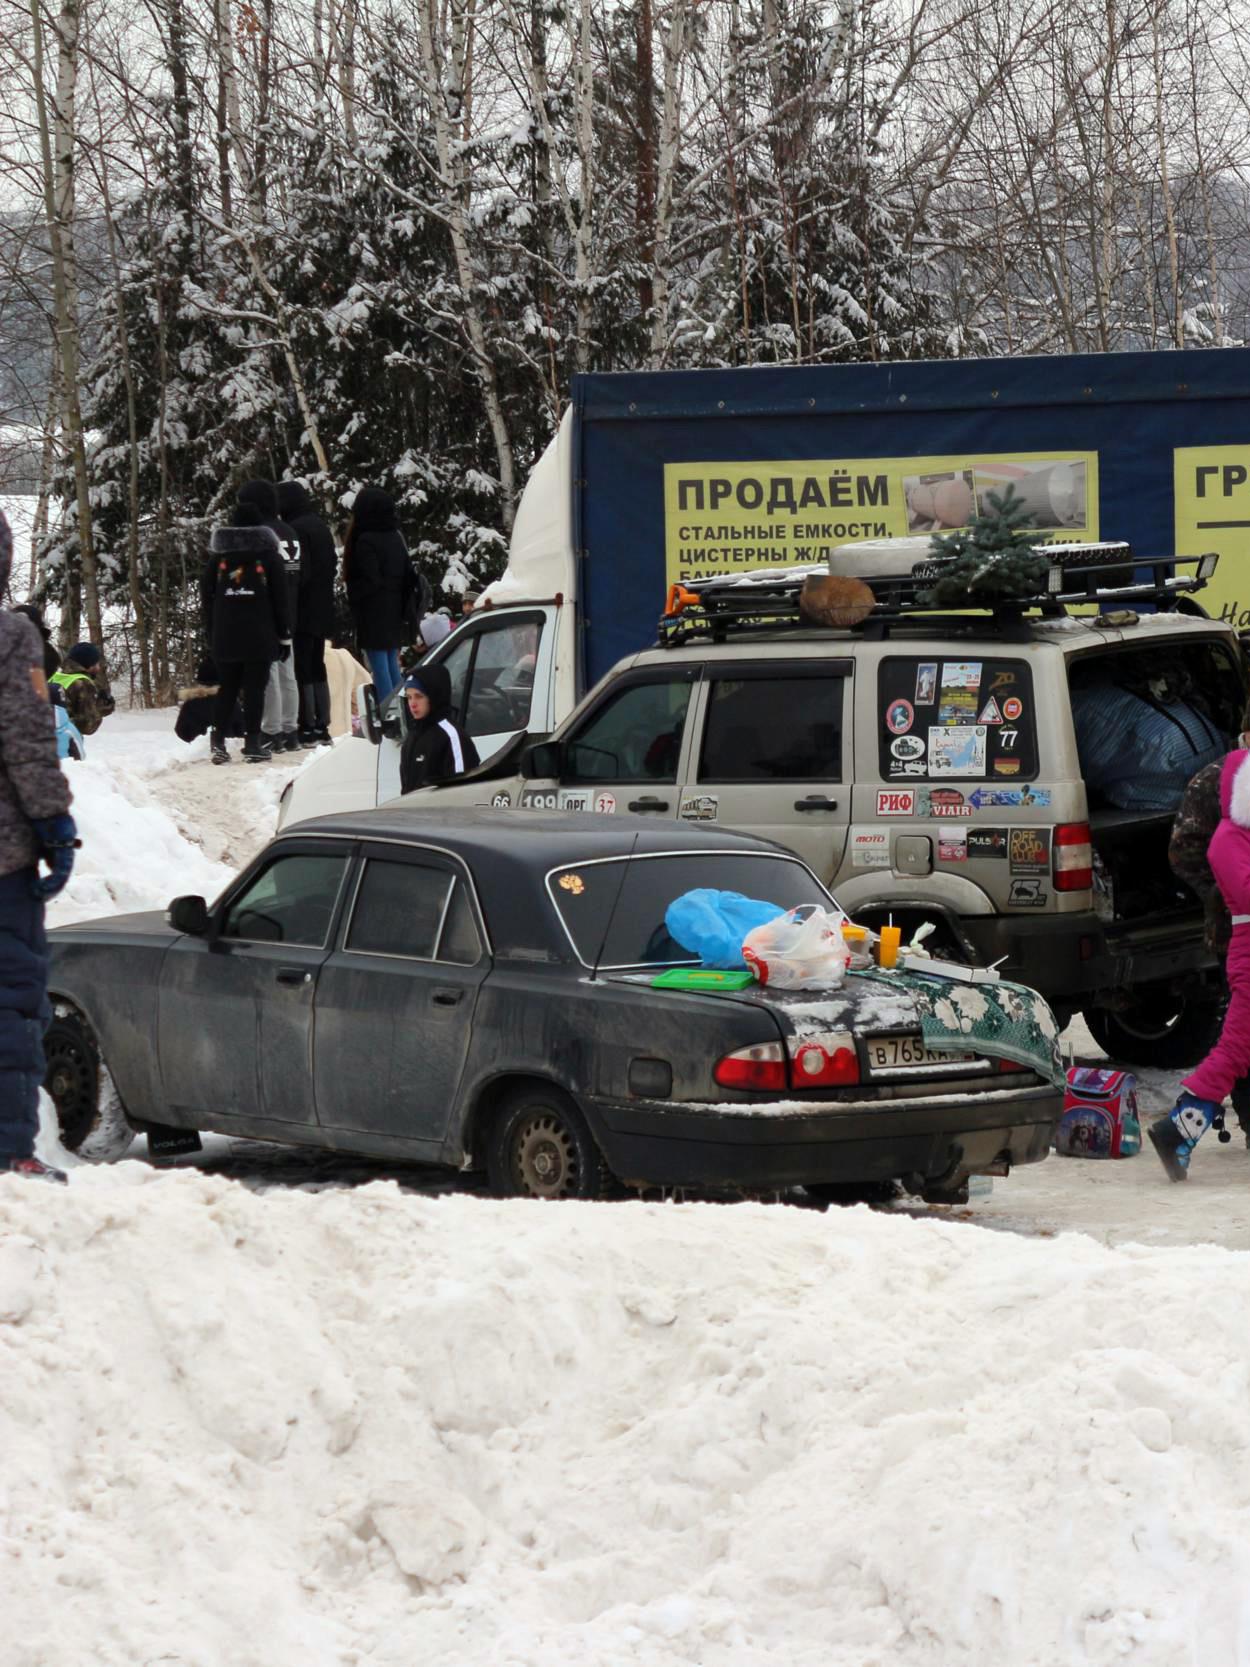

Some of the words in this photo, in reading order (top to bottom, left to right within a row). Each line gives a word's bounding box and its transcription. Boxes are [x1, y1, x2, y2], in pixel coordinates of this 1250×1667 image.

[678, 470, 890, 516] ПРОДАЁМ
[679, 526, 786, 541] СТАЛЬНЫЕ
[793, 522, 893, 540] ЕМКОСТИ,
[679, 546, 788, 566] ЦИСТЕРНЫ
[999, 731, 1018, 748] 77
[878, 794, 912, 811] РИФ
[932, 805, 970, 816] VIAIR
